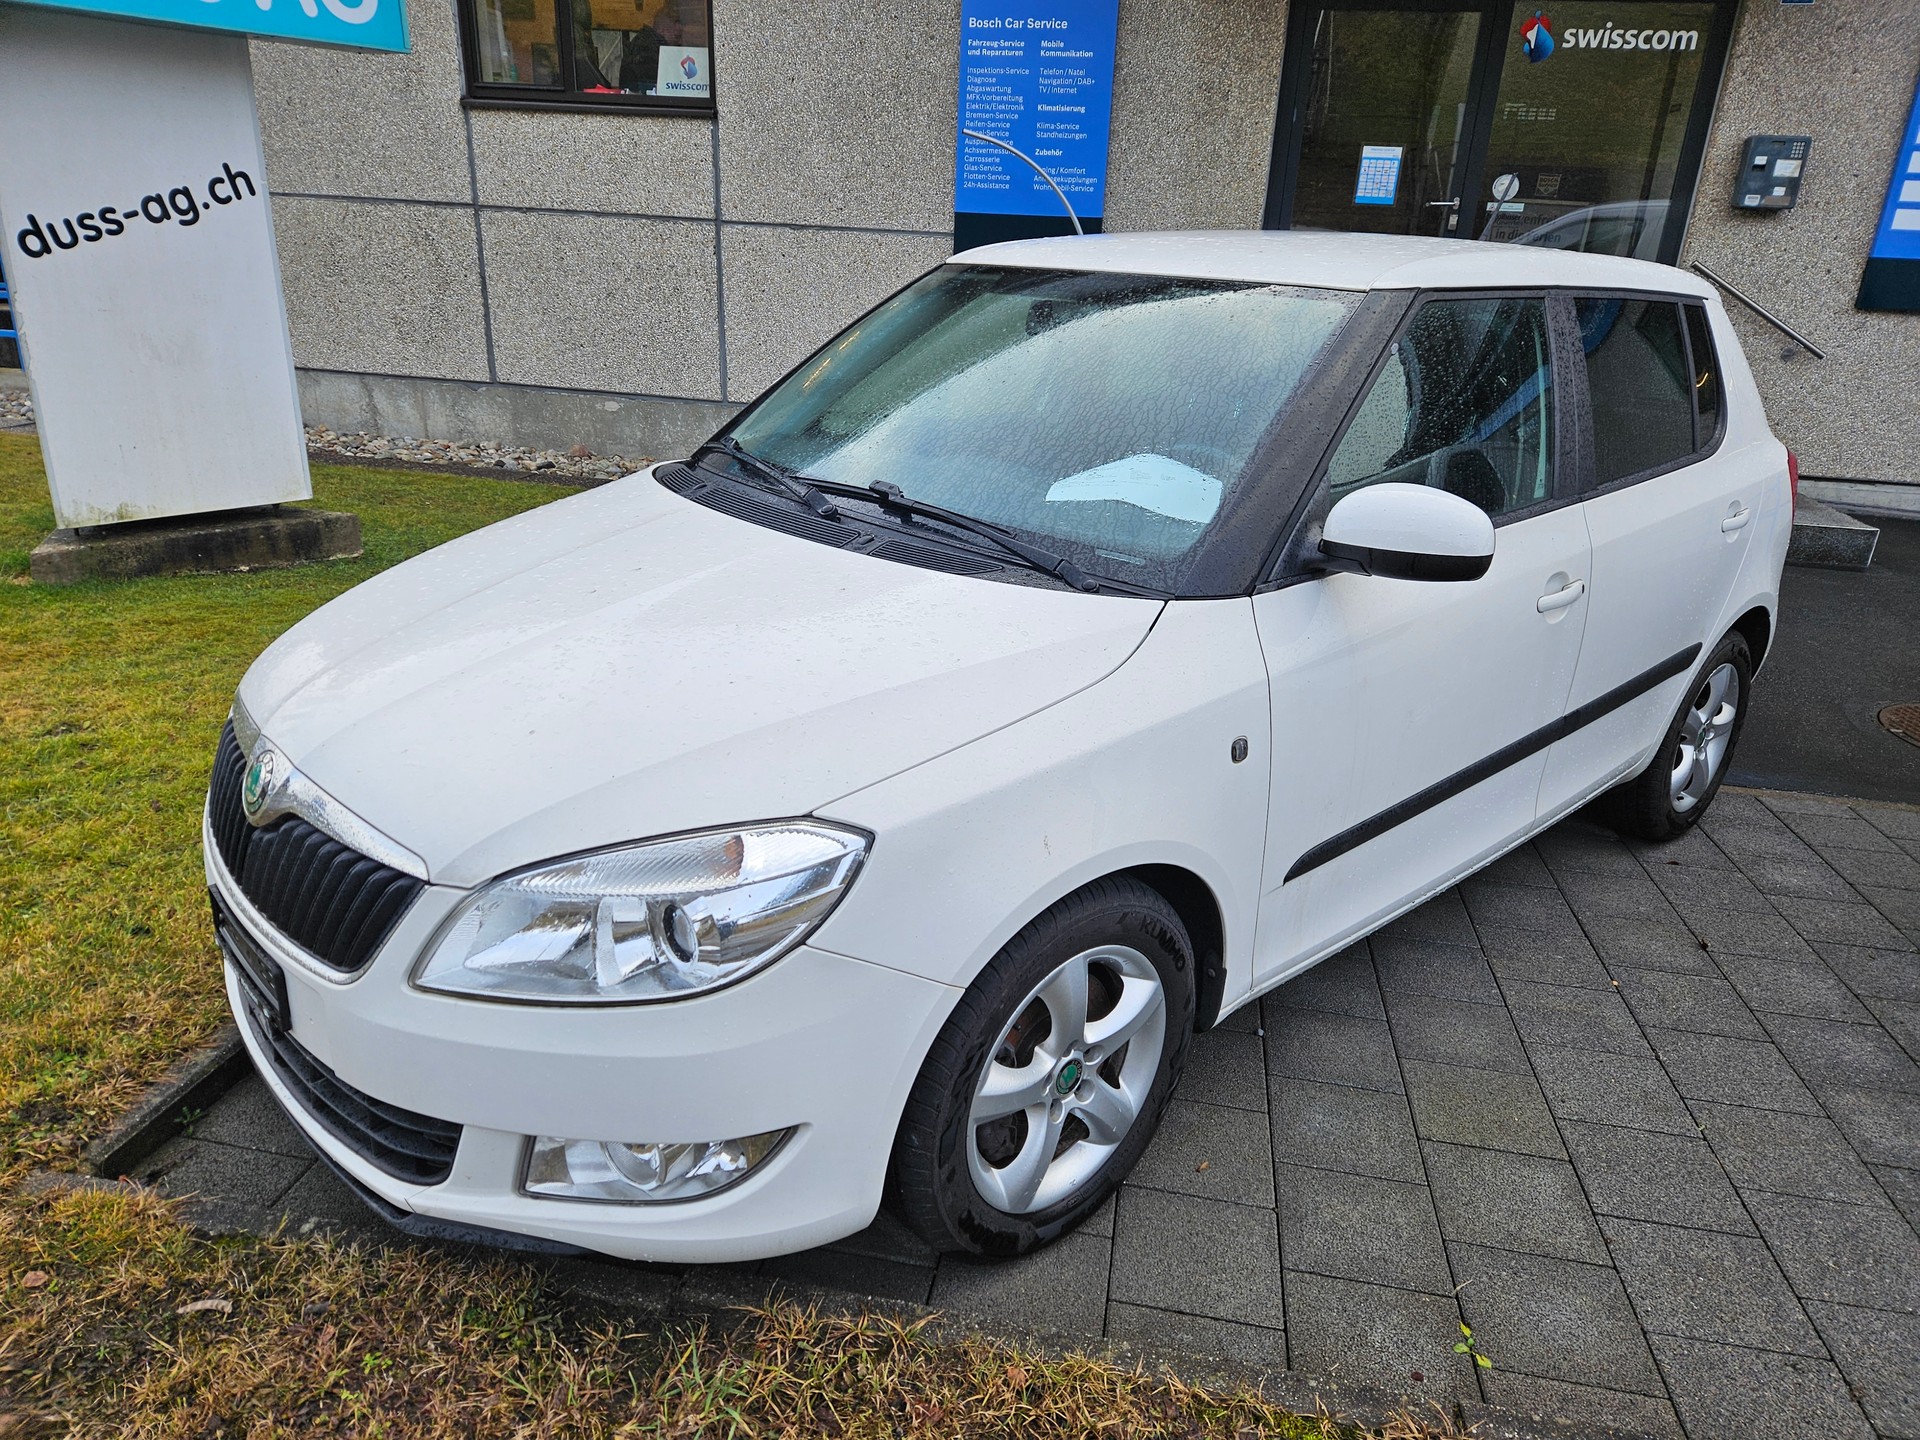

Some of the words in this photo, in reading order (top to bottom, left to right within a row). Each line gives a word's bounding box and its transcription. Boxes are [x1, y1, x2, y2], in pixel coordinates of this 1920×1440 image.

[969, 17, 1001, 28] Bosch
[1005, 18, 1024, 28] Car
[1027, 18, 1068, 29] Service
[1562, 22, 1698, 51] swisscom
[968, 39, 1025, 48] Fahrzeug-Service
[1041, 40, 1064, 48] Mobile
[982, 49, 1023, 57] Reparaturen
[1040, 50, 1093, 58] Kommunikation
[967, 67, 1030, 75] Inspektions-Service
[967, 76, 996, 84] Diagnose
[966, 85, 1012, 93] Abgaswartung
[966, 94, 1024, 103] MFK-Vorbereitung
[966, 103, 1024, 111] Elektrik/Elektronik
[1037, 104, 1086, 113] Klimatisierung
[965, 121, 1011, 129] Reifen-Service
[1036, 122, 1080, 130] Klima-Service
[1036, 131, 1088, 139] Standheizungen
[964, 147, 1016, 156] Achsvermessun
[964, 164, 1003, 172] Glas-Service
[964, 173, 1011, 181] Flotten-Service
[963, 182, 1010, 190] 24h-Assistance
[17, 162, 256, 258] duss-ag.ch
